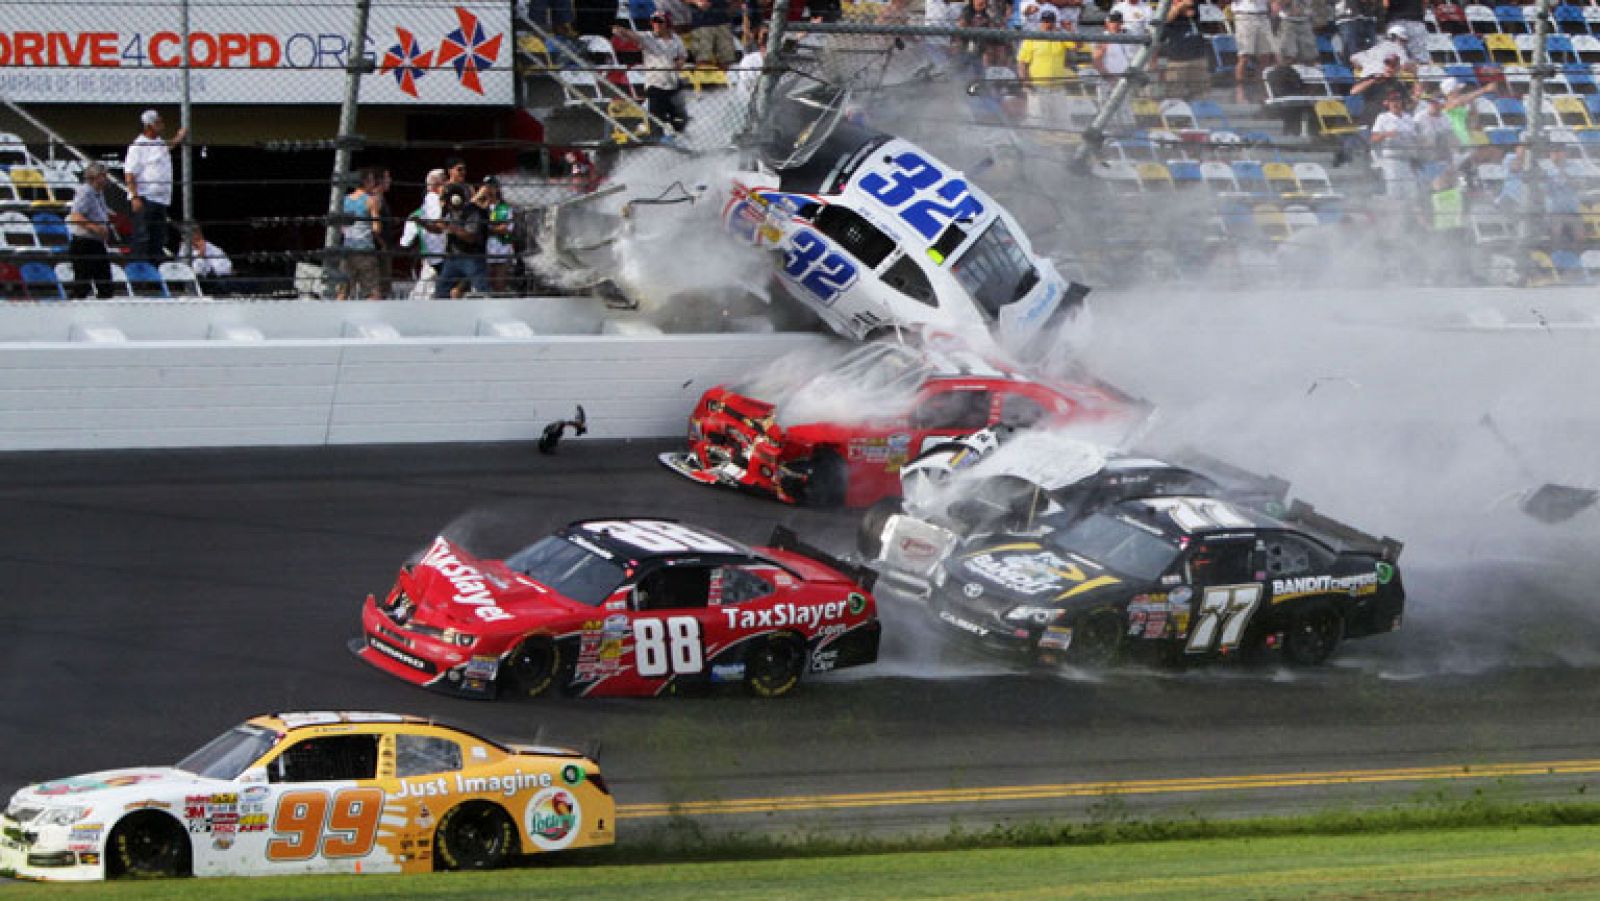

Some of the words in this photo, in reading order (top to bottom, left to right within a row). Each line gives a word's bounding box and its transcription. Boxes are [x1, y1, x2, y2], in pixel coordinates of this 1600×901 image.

[858, 151, 984, 242] 32
[782, 229, 859, 304] 32
[632, 616, 703, 677] 88
[721, 599, 848, 629] TaxSlayer
[1186, 583, 1264, 654] 77
[184, 806, 206, 819] 3M
[397, 776, 450, 798] Just
[455, 767, 553, 797] Imagine
[264, 788, 385, 862] 99
